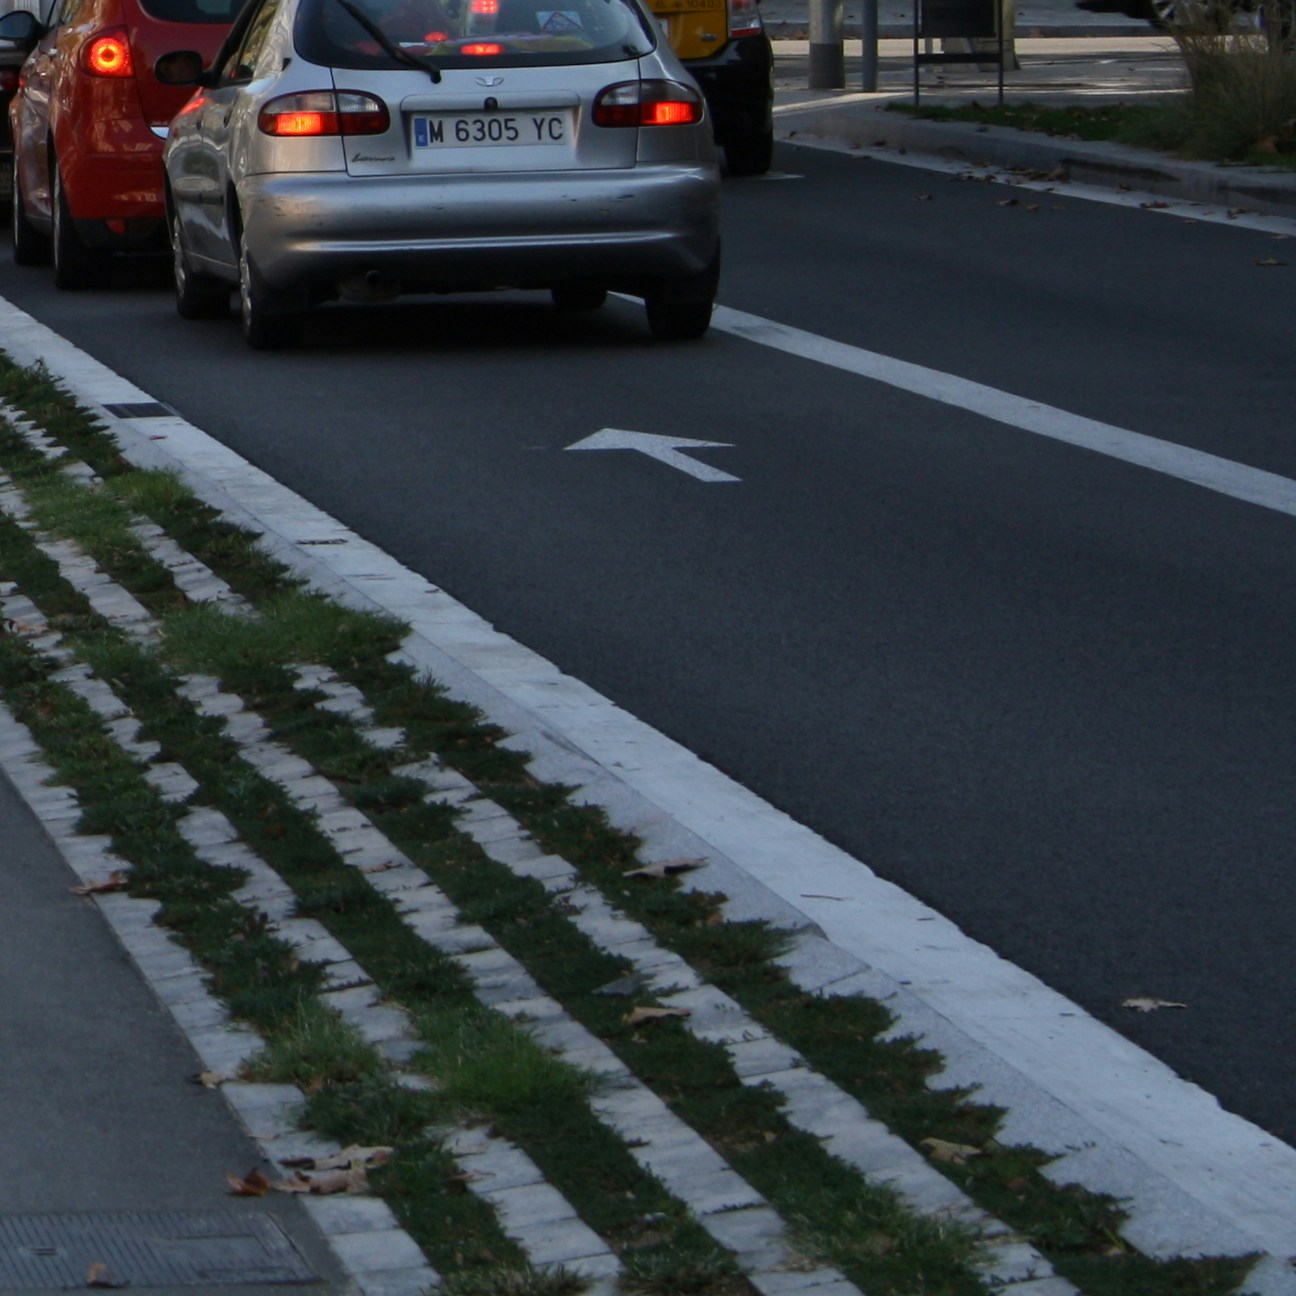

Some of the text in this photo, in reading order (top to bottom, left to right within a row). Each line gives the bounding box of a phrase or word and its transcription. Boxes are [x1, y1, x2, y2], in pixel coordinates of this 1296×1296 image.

[428, 116, 564, 143] M 6305 YC
